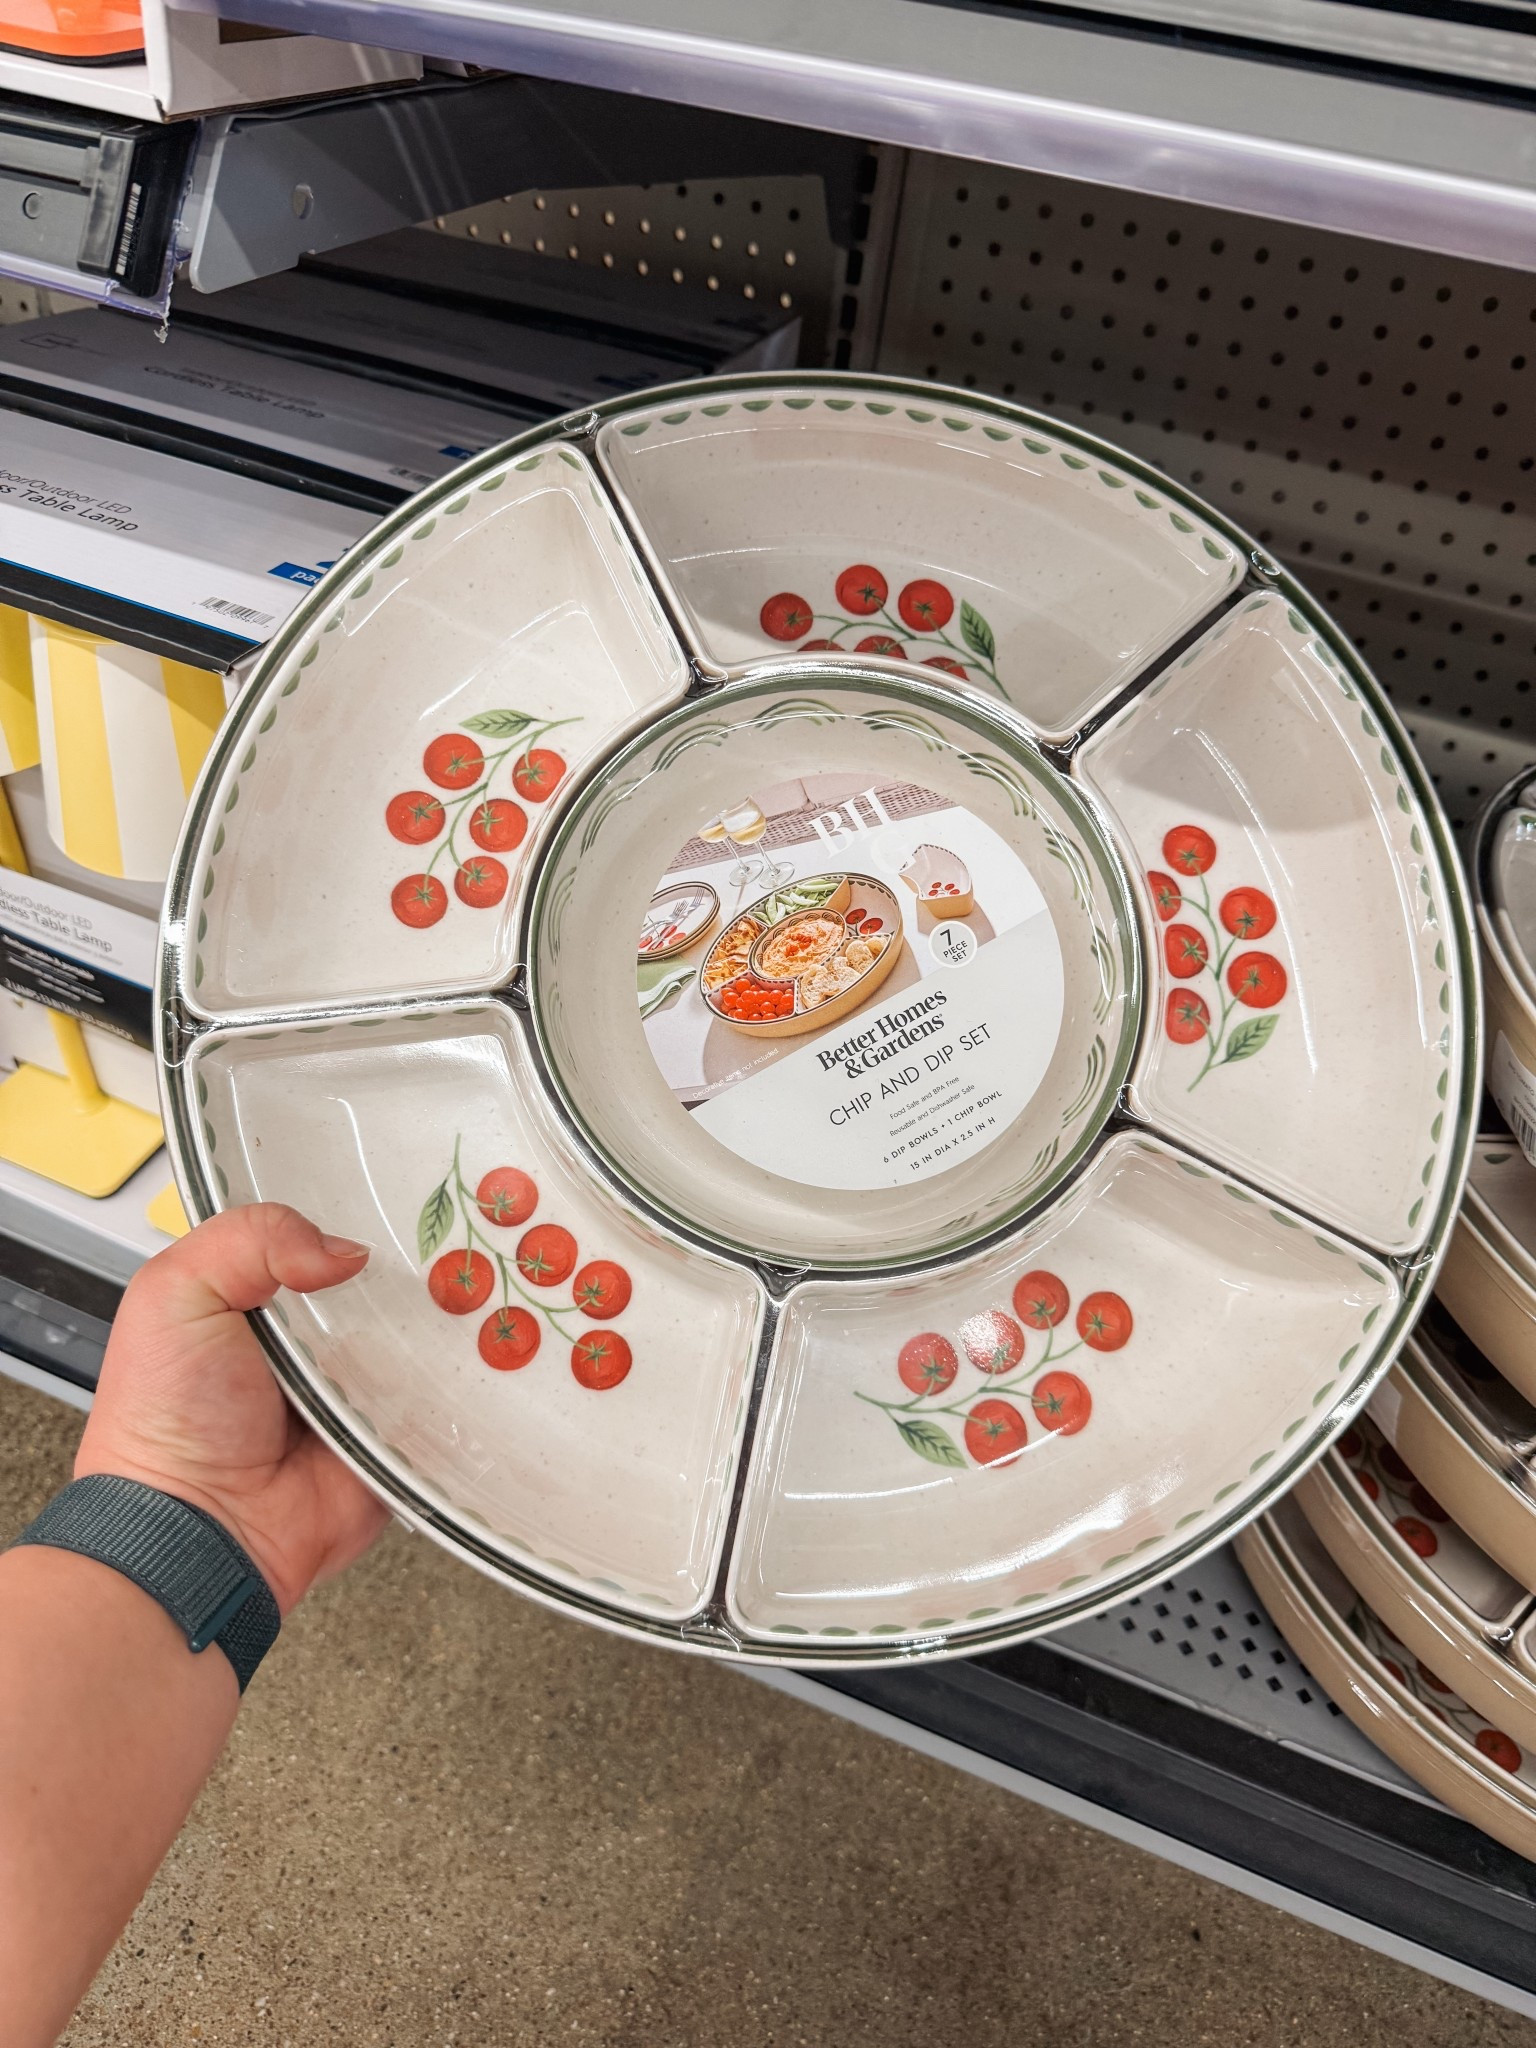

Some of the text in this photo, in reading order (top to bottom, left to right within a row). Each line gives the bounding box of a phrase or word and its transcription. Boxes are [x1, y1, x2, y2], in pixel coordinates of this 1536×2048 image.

[19, 488, 76, 512] Table
[77, 507, 139, 531] Lamp
[97, 500, 132, 514] LED
[30, 911, 71, 936] Table
[74, 927, 113, 953] Lamp
[939, 928, 953, 946] 7
[942, 940, 968, 958] PIECE
[951, 950, 968, 963] SET
[815, 990, 948, 1073] Better Homes
[692, 1078, 725, 1099] Decorative
[741, 1062, 753, 1072] not
[829, 1022, 991, 1126] CHIP AND DIP SET
[889, 1076, 960, 1120] Food Safe and BPA Free
[889, 1083, 975, 1137] Reusable and Dishwasher Safe
[890, 1145, 906, 1159] DIP
[908, 1127, 939, 1149] BOWLS
[954, 1105, 975, 1121] CHIP
[976, 1090, 1003, 1108] BOWL
[910, 1116, 996, 1171] 15 IN DIA X 2.5 IN H
